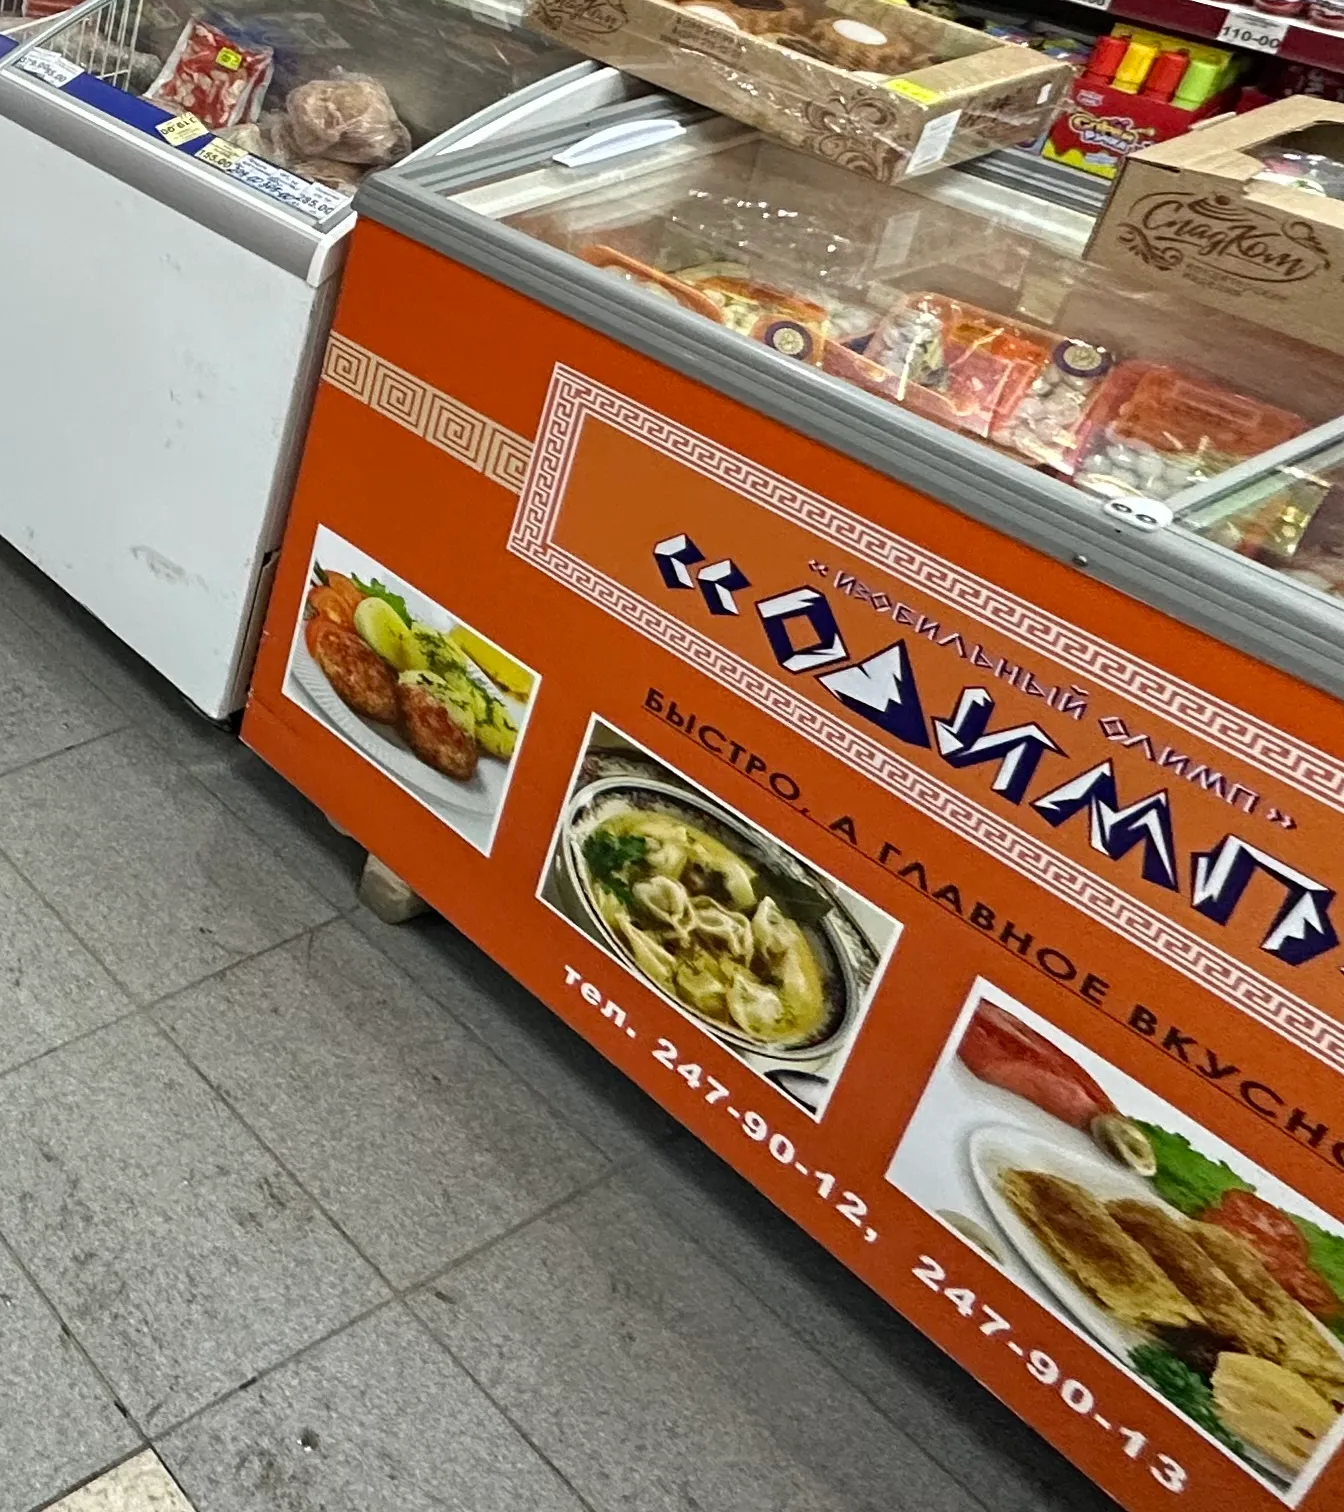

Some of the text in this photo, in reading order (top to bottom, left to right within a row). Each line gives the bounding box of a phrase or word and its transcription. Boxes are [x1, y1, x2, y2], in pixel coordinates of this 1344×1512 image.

[1222, 24, 1281, 50] 110-00
[640, 687, 815, 817] БЫСТРО,
[876, 843, 1111, 1002] ГЛАВНОЕ
[561, 965, 640, 1039] тел.
[909, 1254, 1190, 1496] 247-90-13
